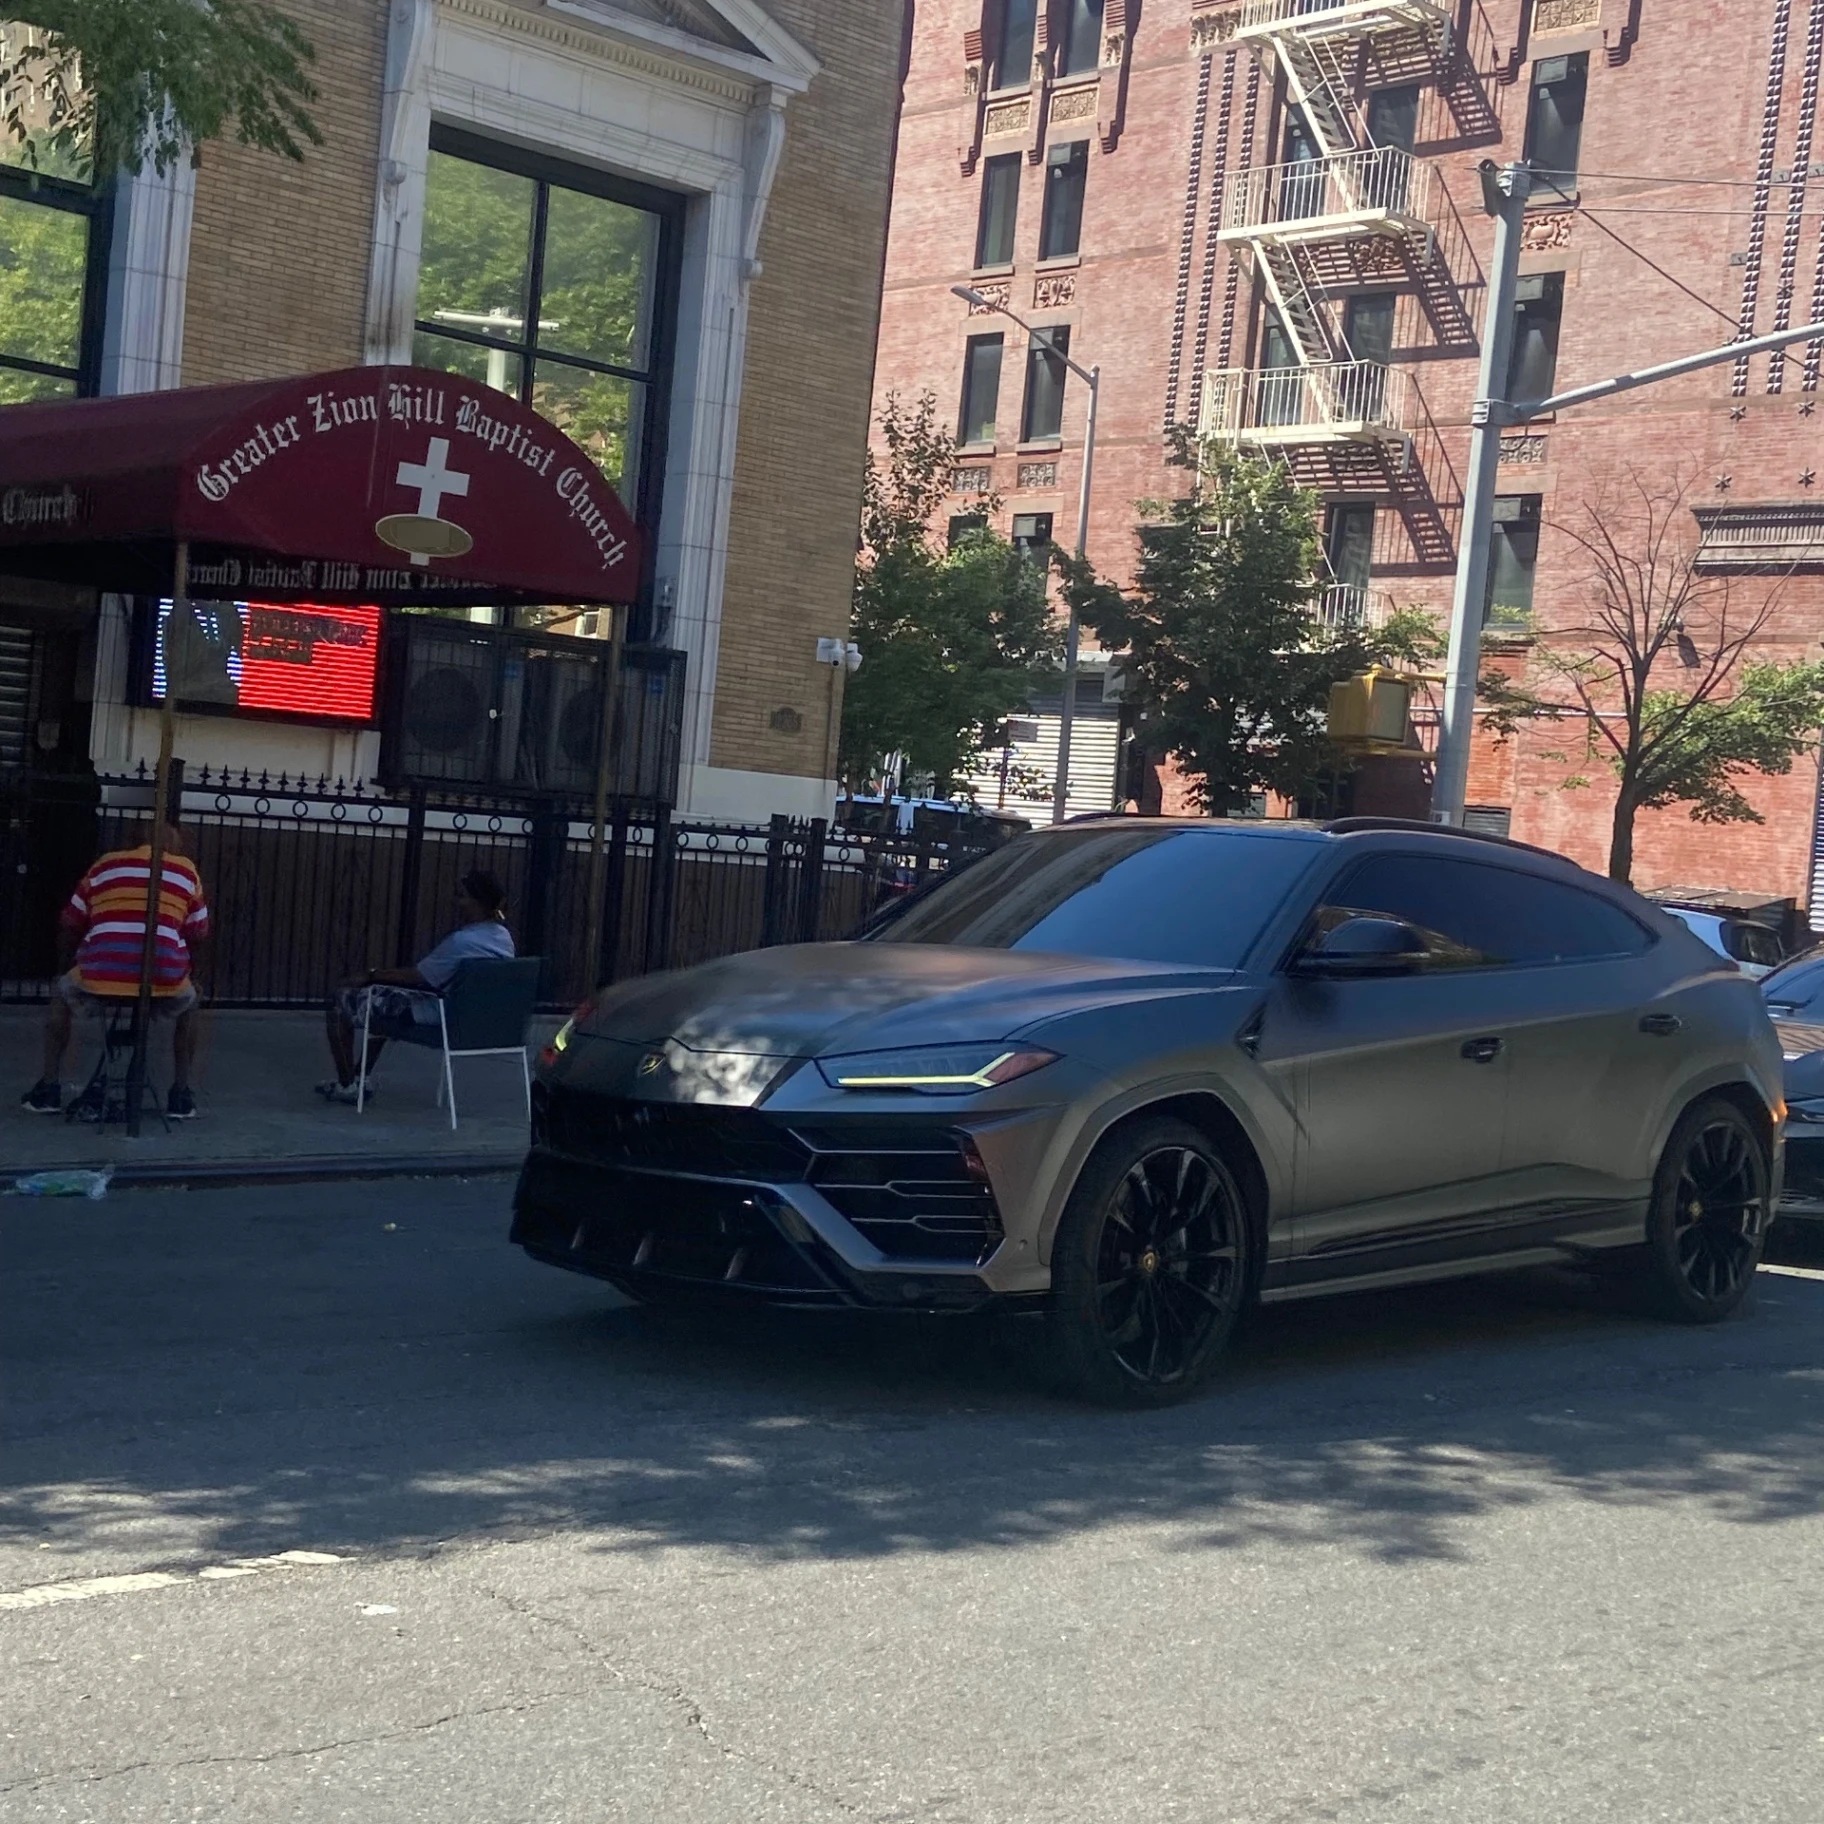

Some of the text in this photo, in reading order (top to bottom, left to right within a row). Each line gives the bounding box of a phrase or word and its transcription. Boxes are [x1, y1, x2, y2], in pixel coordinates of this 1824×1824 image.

[196, 383, 630, 571] Greater Zion Hill Baptist Church
